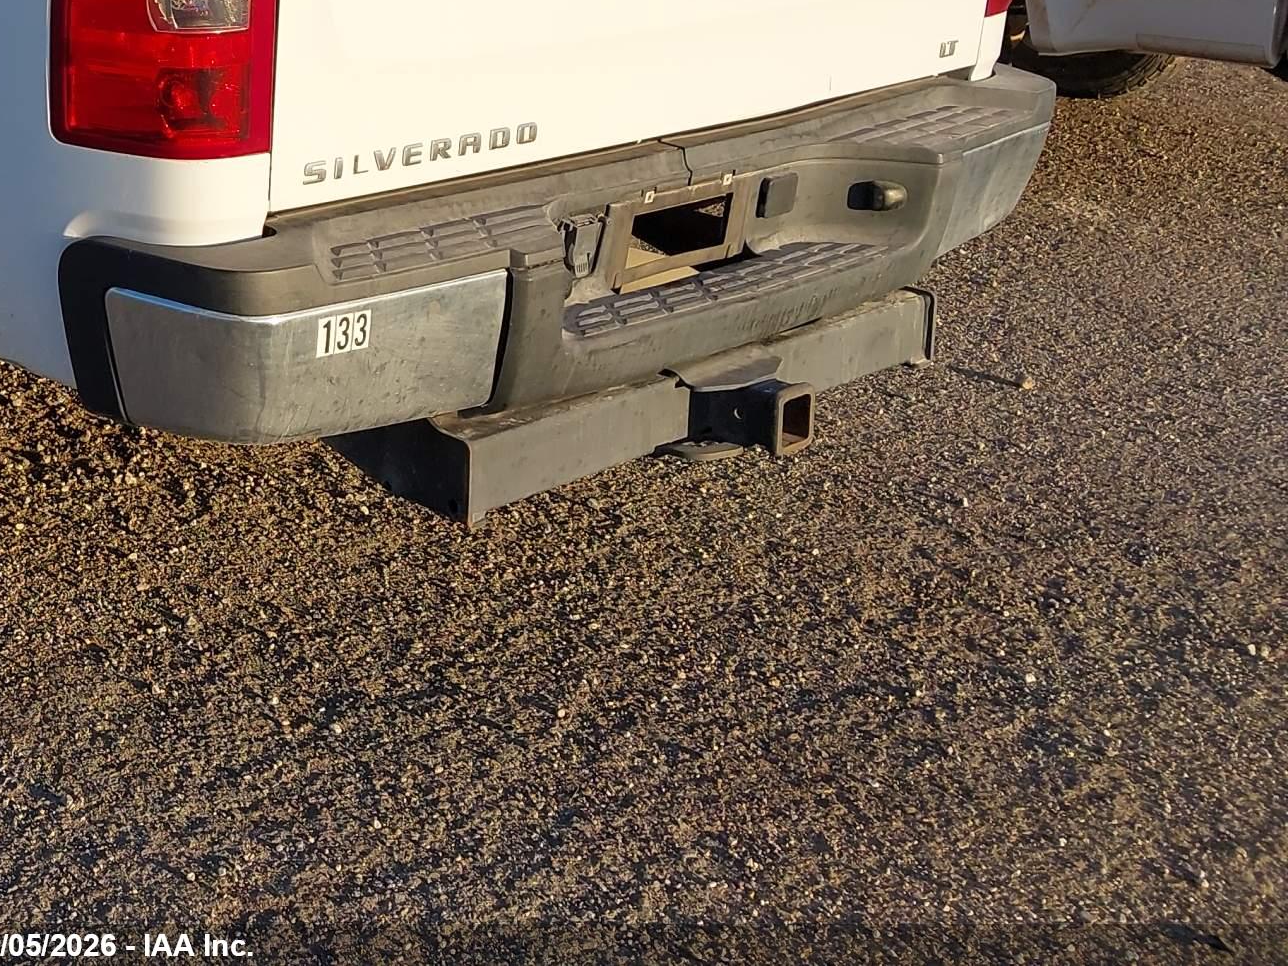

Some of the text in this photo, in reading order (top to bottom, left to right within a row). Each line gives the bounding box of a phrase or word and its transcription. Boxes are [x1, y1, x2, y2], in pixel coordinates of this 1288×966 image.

[939, 40, 959, 58] LT
[302, 121, 538, 185] SILVERADO
[322, 313, 368, 354] 133
